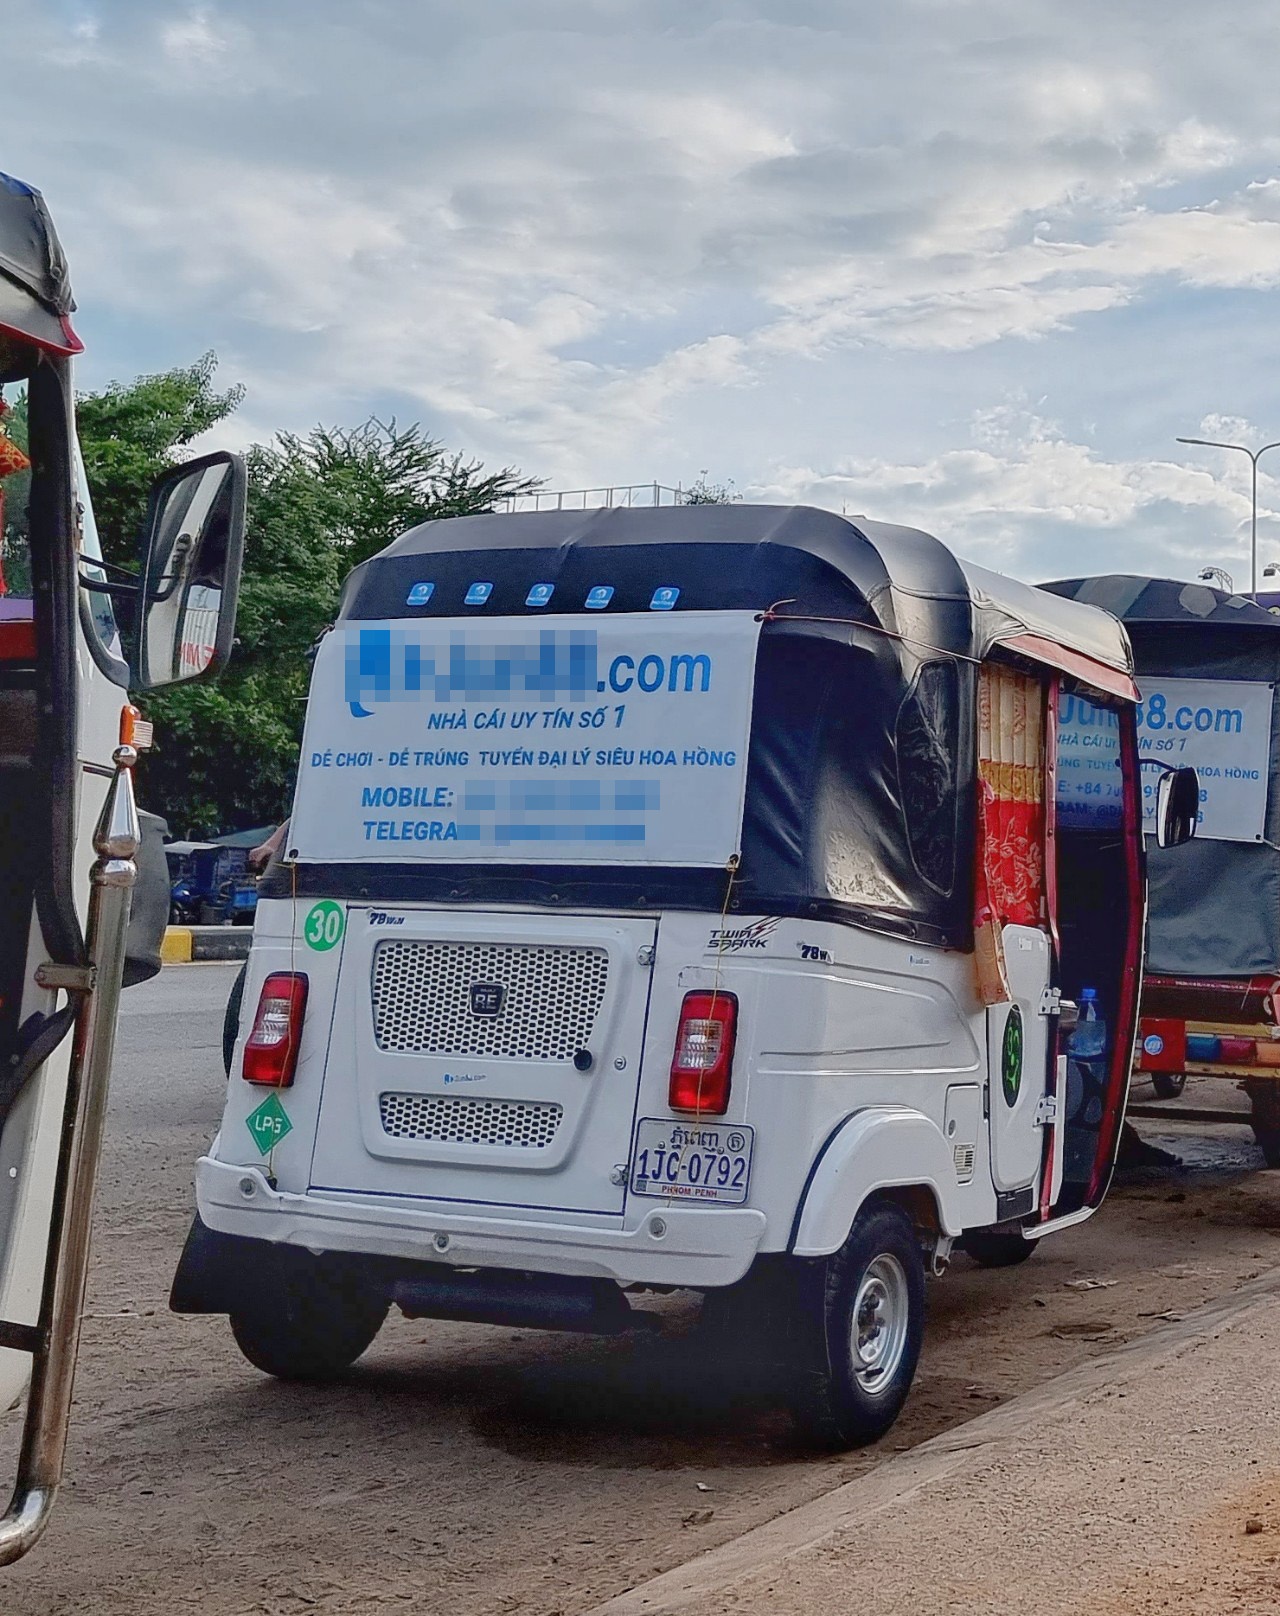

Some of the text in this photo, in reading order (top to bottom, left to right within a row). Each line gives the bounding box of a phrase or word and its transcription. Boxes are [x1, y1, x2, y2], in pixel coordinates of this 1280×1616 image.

[427, 704, 626, 730] NHÀ CÁI UY TÍN SỐ 1
[1138, 736, 1152, 750] ÍN
[1155, 737, 1175, 751] SỐ
[336, 751, 373, 768] CHƠI
[414, 748, 469, 767] TRÚNG
[538, 751, 567, 769] ĐẠI
[572, 747, 591, 766] LÝ
[596, 747, 635, 766] SIÊU
[639, 750, 677, 766] HOA
[682, 746, 736, 767] HỒNG
[1225, 766, 1259, 781] HỒNG
[361, 787, 453, 808] MOBILE:
[363, 821, 458, 841] TELEGRA
[308, 909, 341, 944] 30
[710, 929, 752, 939] TWIN
[707, 939, 768, 952] SPARK
[474, 994, 498, 1010] RE
[255, 1114, 283, 1134] LPG
[636, 1148, 746, 1188] 1JC-0792
[661, 1184, 718, 1198] PHNOM PENH
